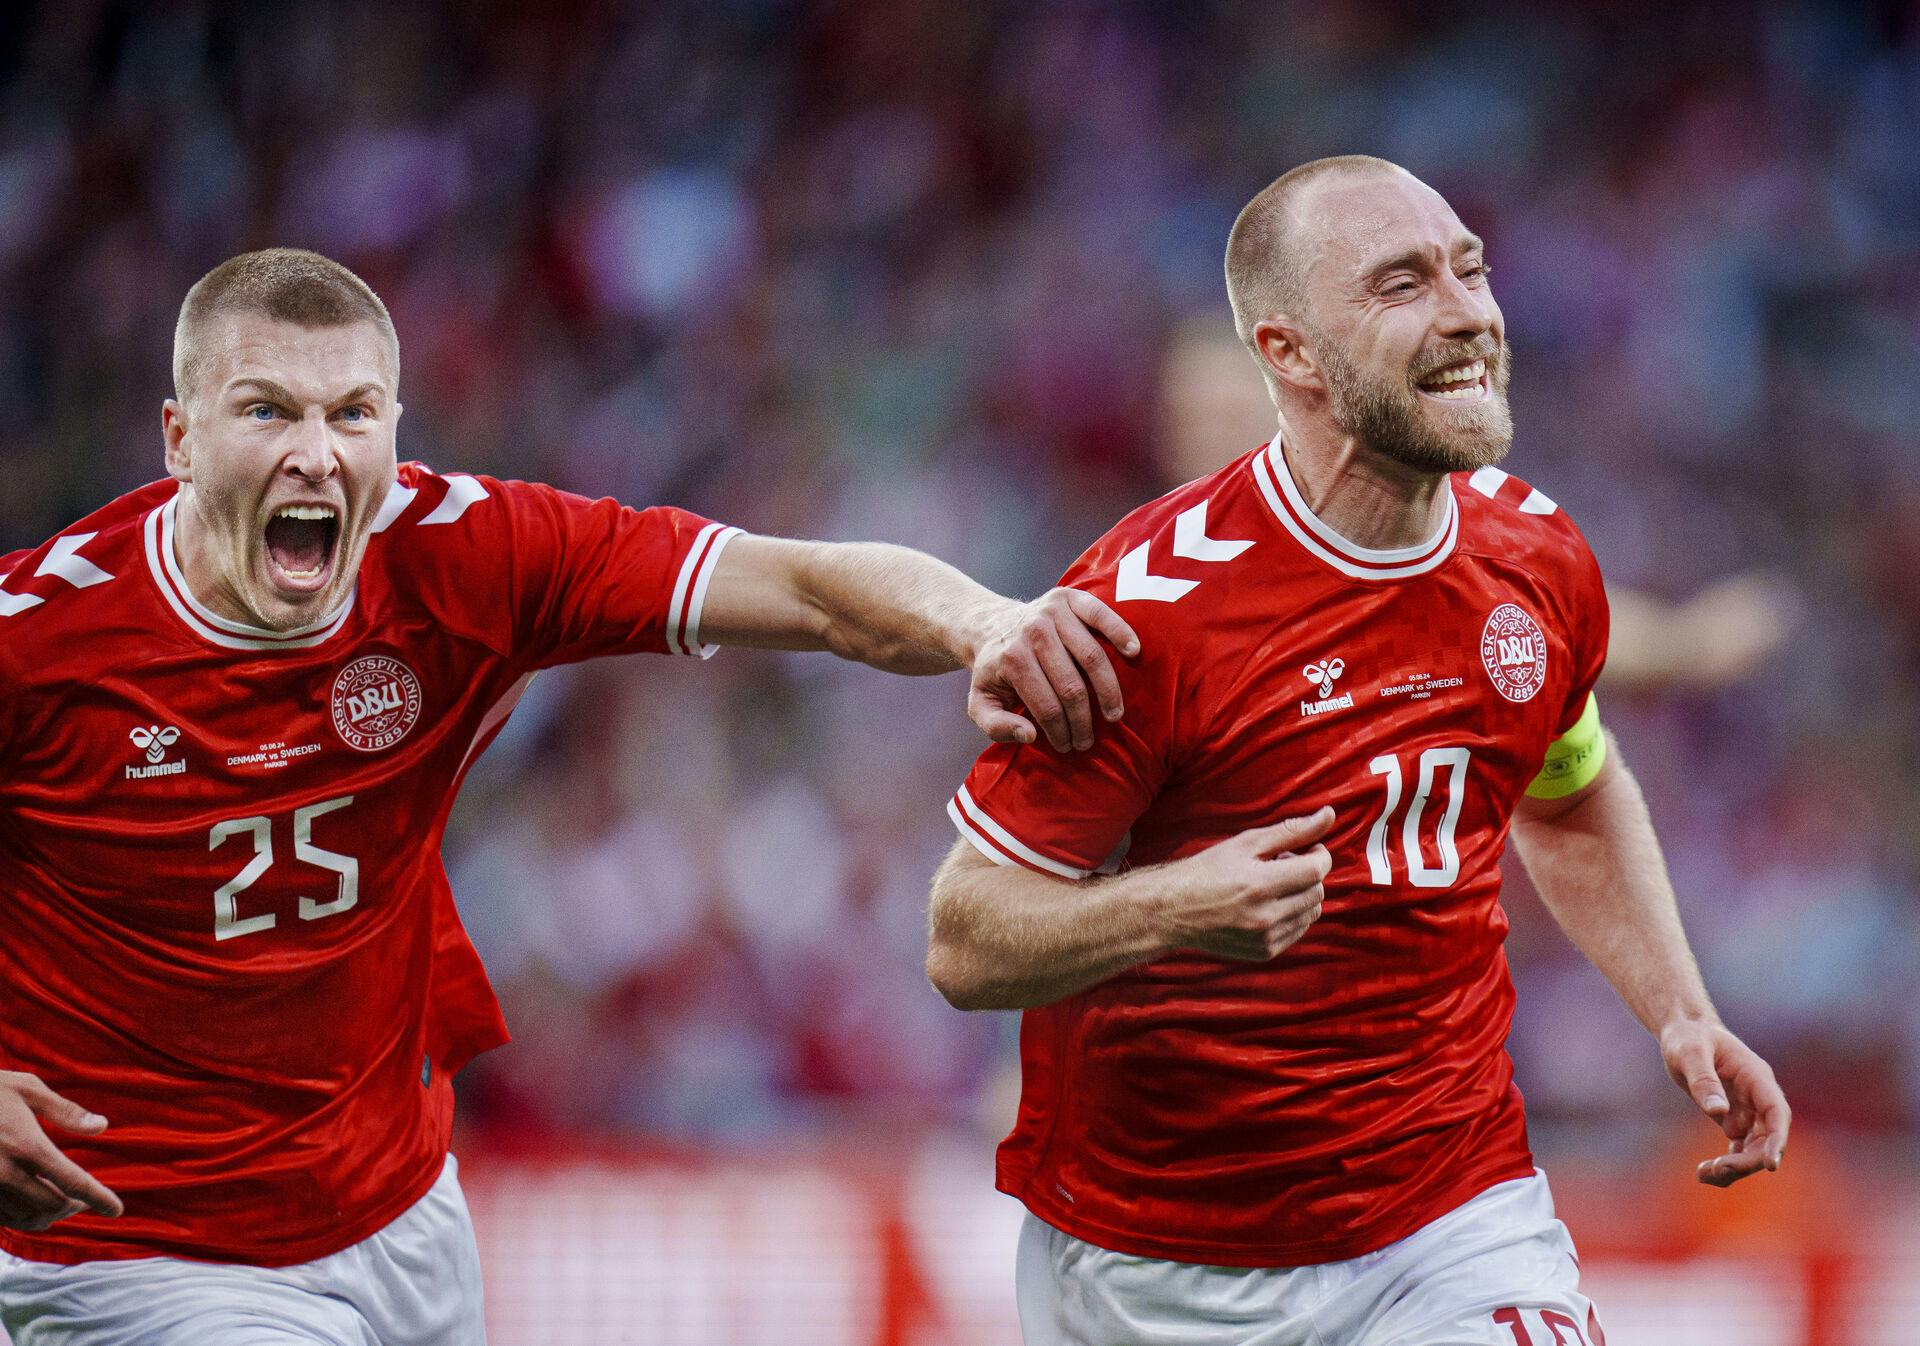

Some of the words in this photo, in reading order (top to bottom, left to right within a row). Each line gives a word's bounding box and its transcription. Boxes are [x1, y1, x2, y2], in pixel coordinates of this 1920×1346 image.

[1497, 636, 1536, 665] DBU
[1483, 634, 1506, 690] DANSK
[1508, 684, 1534, 699] 1889
[346, 681, 403, 723] DBU
[1380, 684, 1415, 697] DENMARK
[1425, 678, 1463, 689] SWEDEN
[1301, 692, 1354, 717] hummel
[334, 697, 362, 746] DANSK
[368, 727, 403, 748] 1889
[125, 758, 187, 780] hummel
[227, 753, 268, 766] DENMARK
[269, 753, 278, 761] vs
[280, 743, 321, 759] SWEDEN
[264, 760, 288, 769] PARKEN
[1366, 748, 1471, 887] 10
[209, 795, 359, 941] 25
